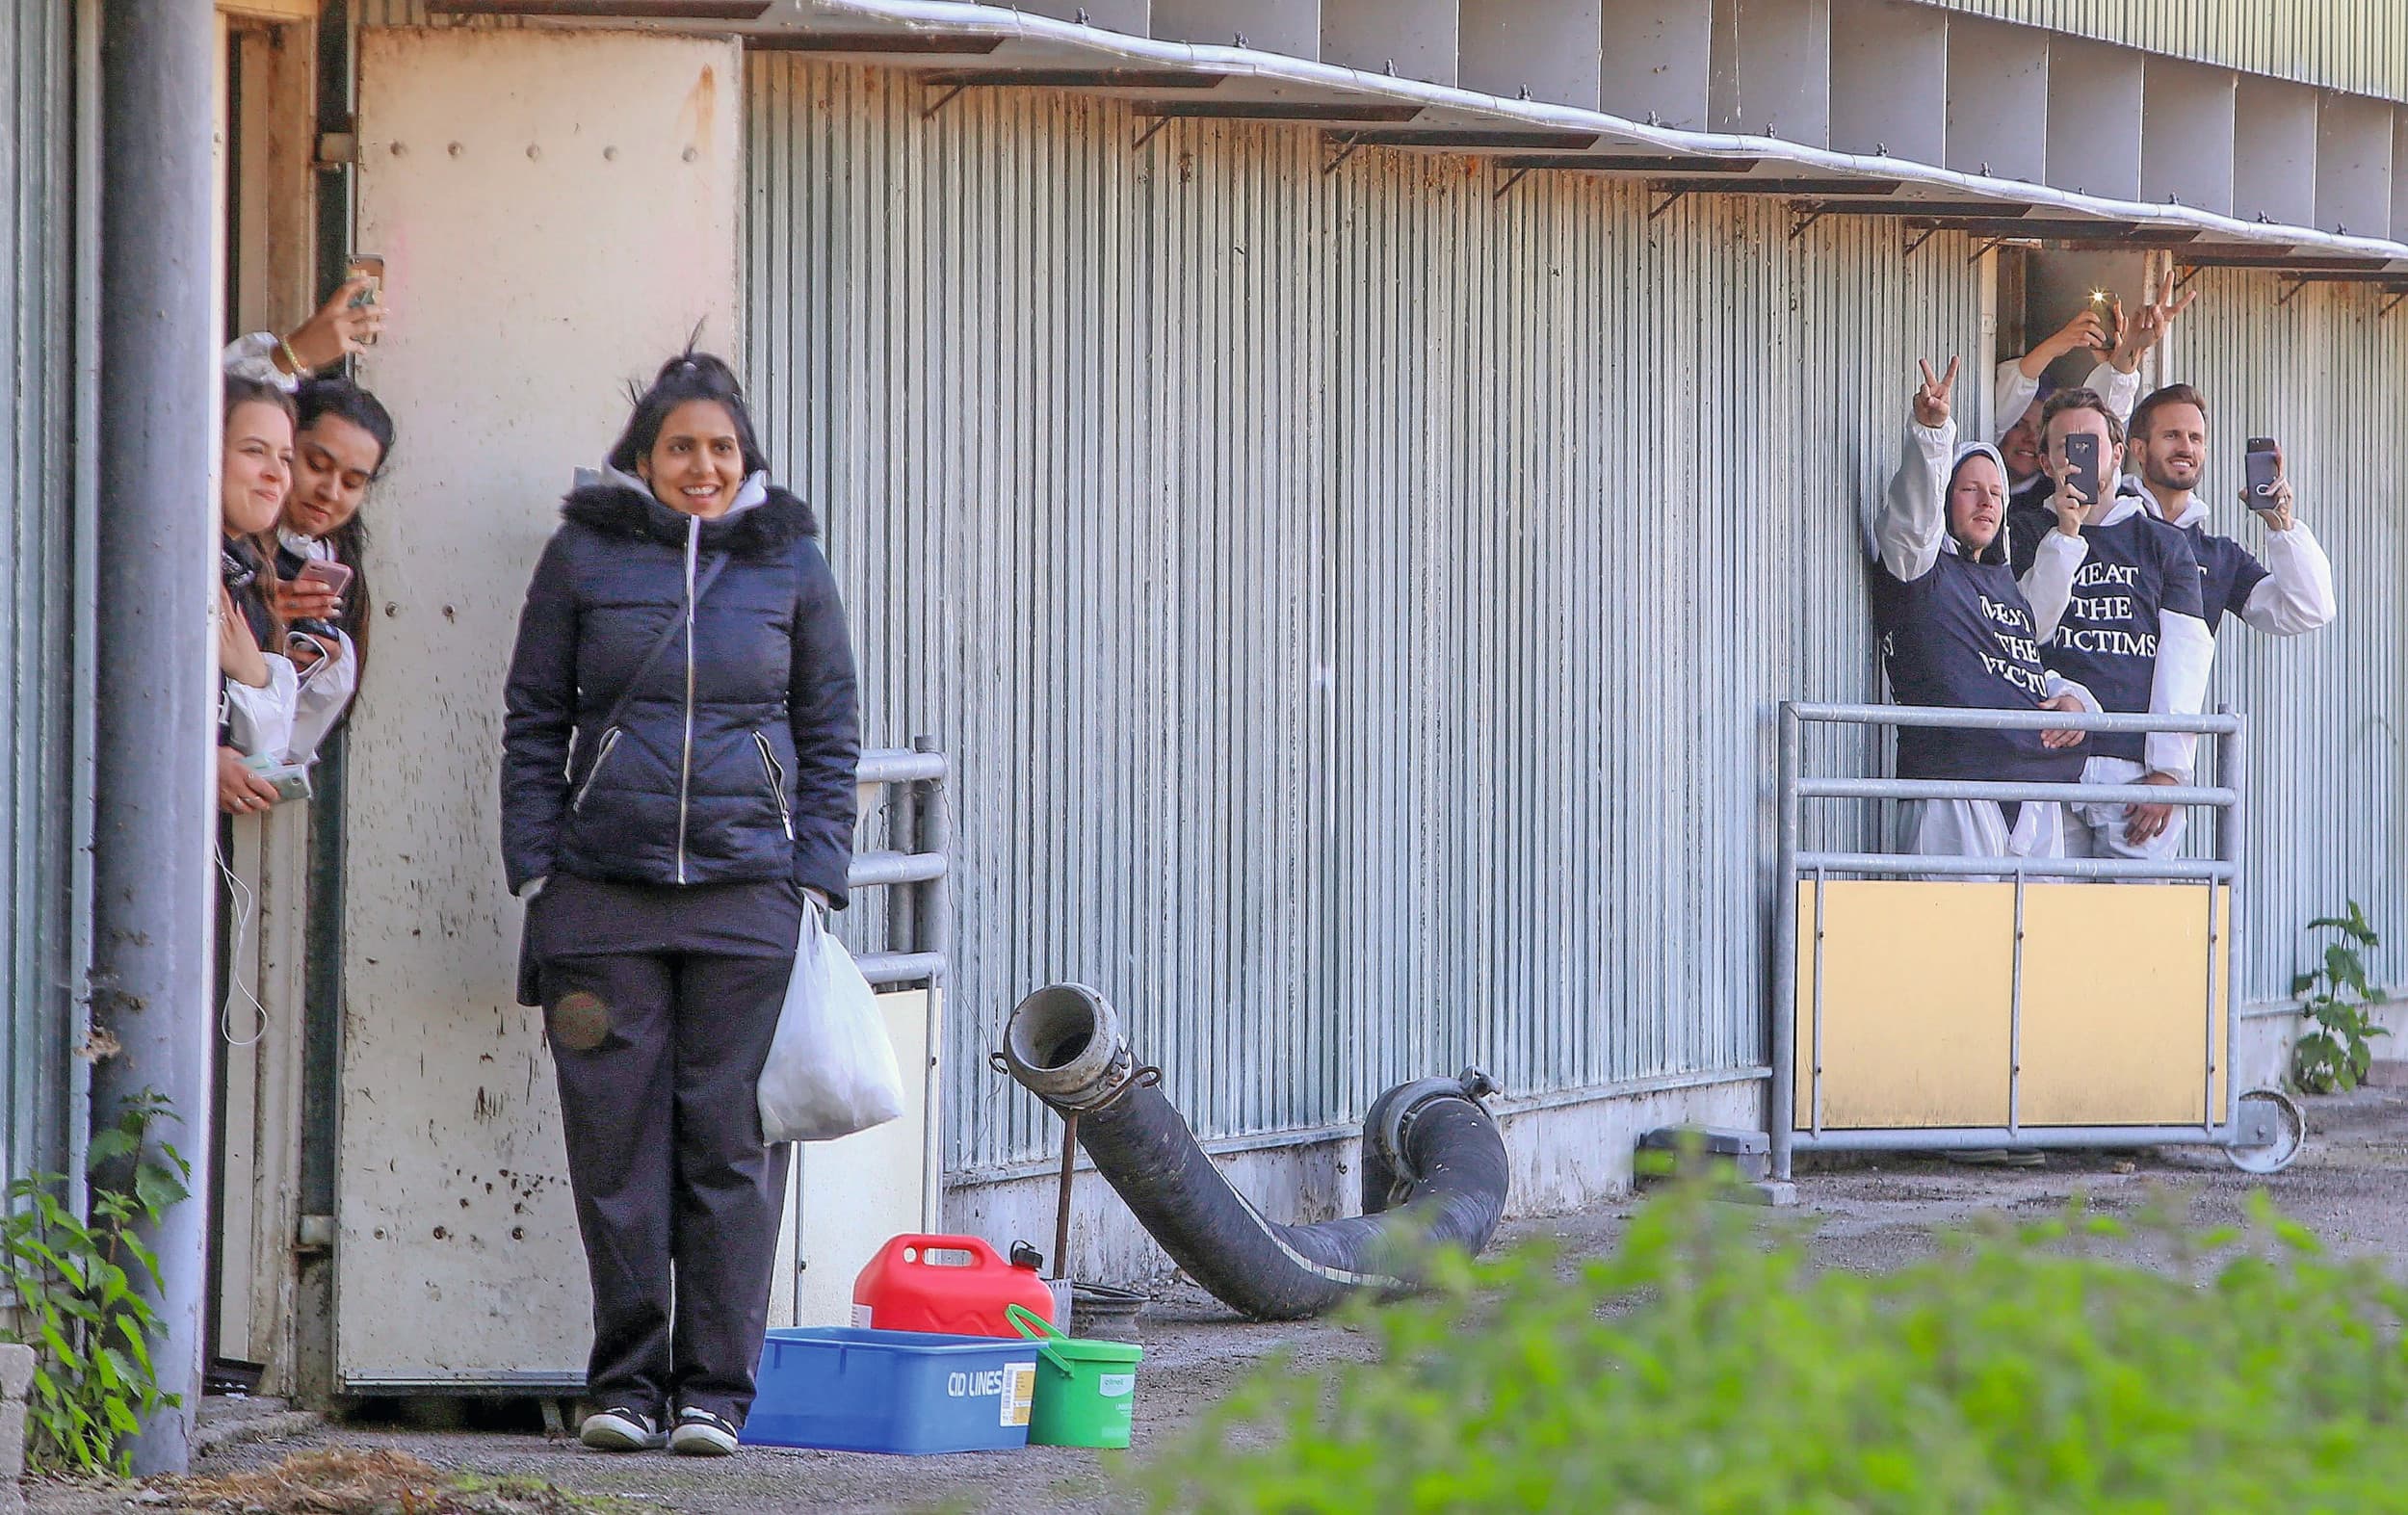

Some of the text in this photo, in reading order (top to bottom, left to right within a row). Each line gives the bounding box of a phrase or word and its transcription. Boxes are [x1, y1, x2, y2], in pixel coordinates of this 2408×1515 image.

[2071, 596, 2133, 621] THE
[1994, 631, 2041, 664] THE
[948, 1371, 966, 1397] CID
[968, 1370, 1002, 1397] LINES
